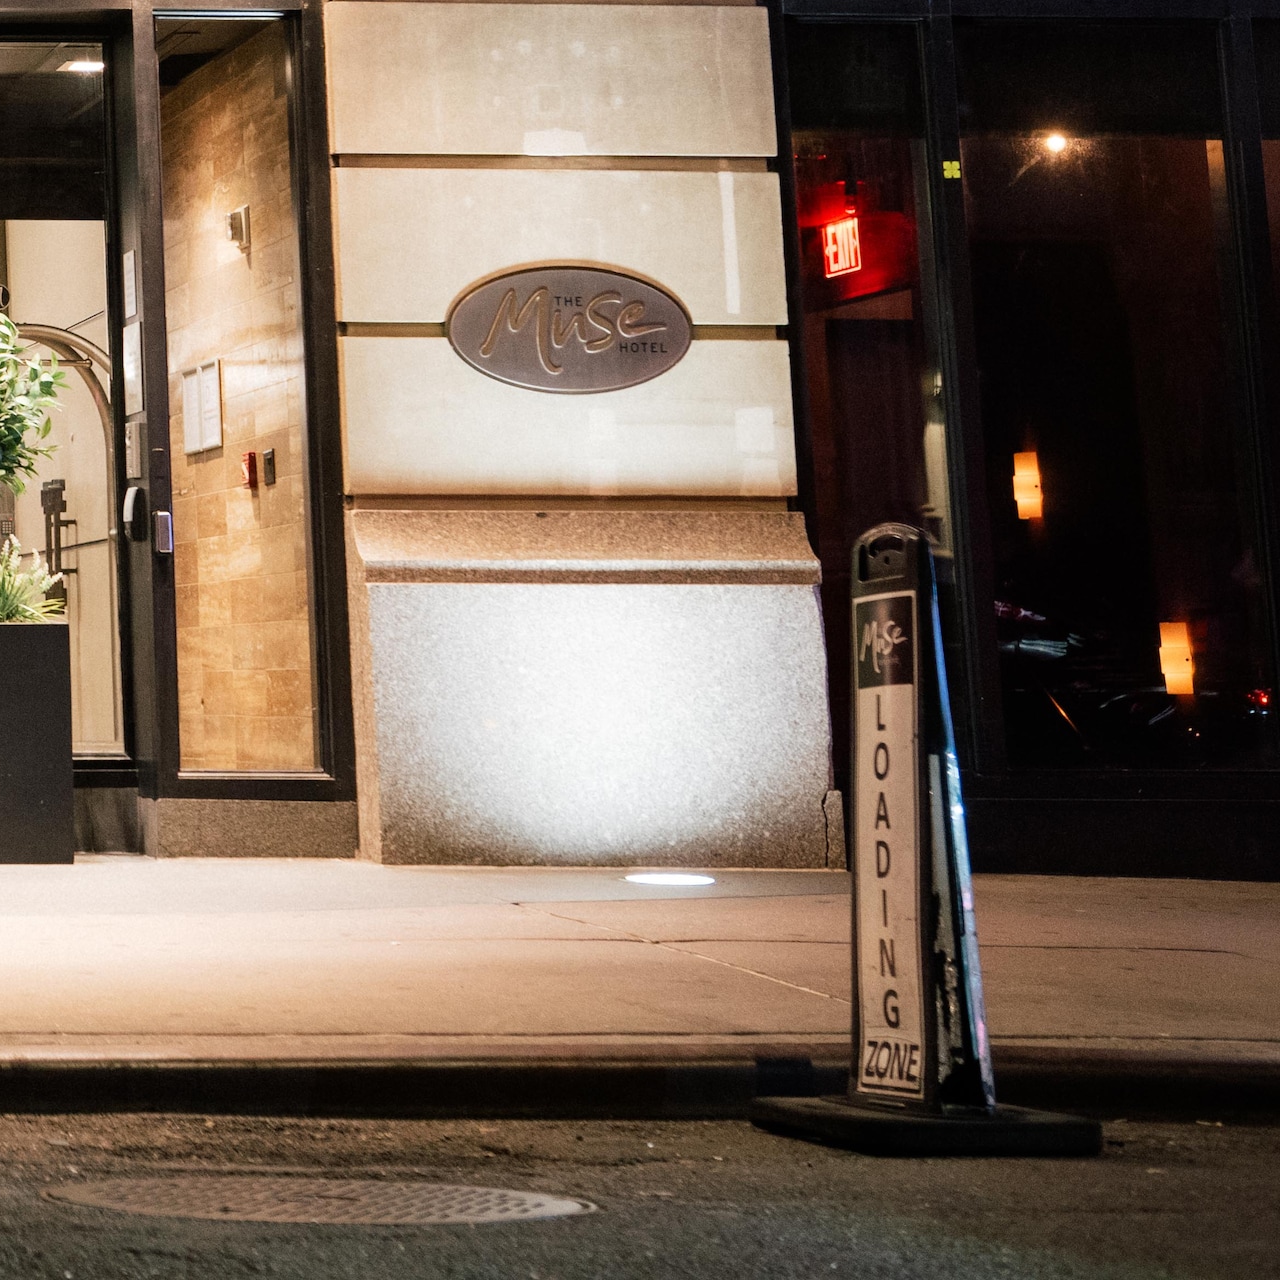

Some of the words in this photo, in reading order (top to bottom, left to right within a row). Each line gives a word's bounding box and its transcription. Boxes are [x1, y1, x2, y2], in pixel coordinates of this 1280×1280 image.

[826, 219, 856, 272] EXIT
[554, 296, 583, 307] THE
[479, 286, 667, 374] Muse
[619, 342, 668, 353] HOTEL
[874, 694, 900, 1030] LOADING
[865, 1040, 919, 1082] ZONE
